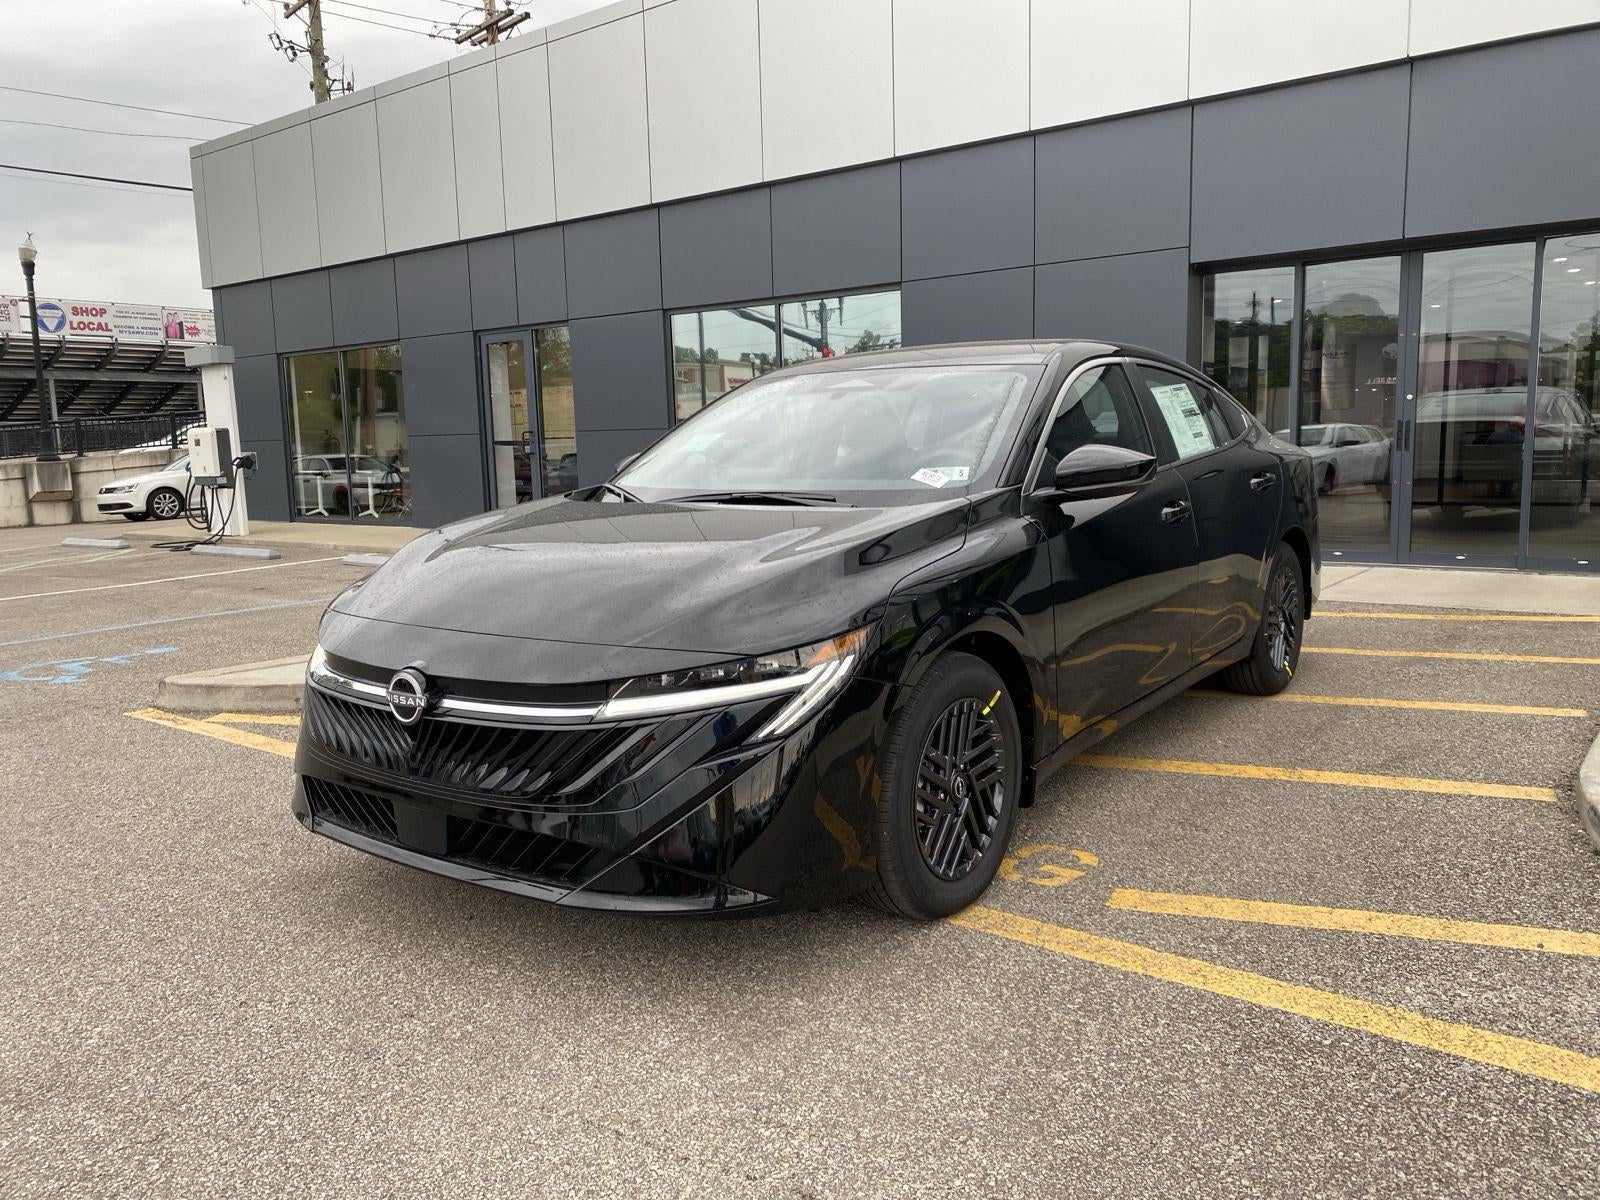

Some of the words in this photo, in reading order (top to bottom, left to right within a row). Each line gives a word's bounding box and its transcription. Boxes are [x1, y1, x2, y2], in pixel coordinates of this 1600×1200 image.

[71, 306, 107, 317] SHOP
[69, 320, 113, 332] LOCAL
[387, 693, 424, 706] NISSAN
